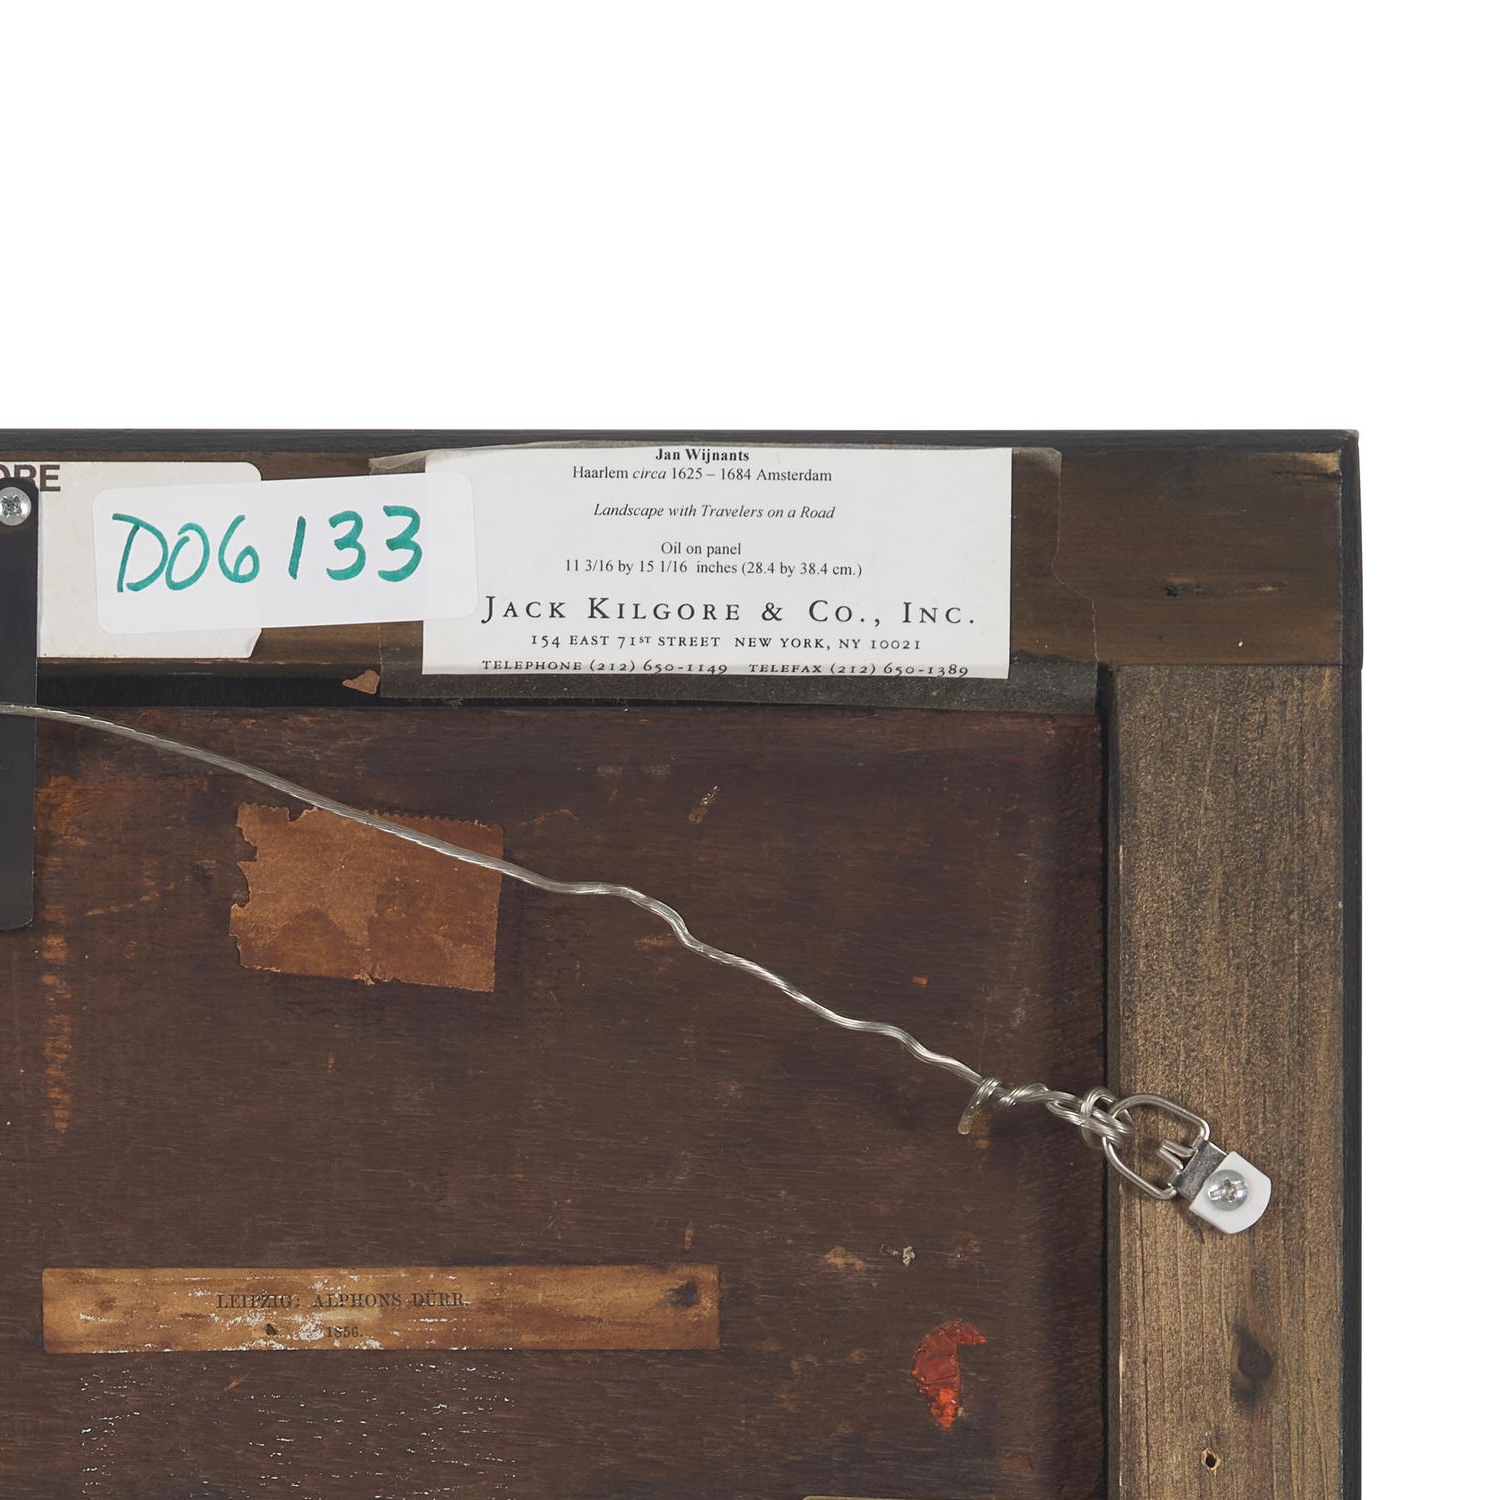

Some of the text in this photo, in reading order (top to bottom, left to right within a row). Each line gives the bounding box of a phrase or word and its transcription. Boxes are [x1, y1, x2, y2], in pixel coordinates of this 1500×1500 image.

[655, 448, 750, 464] Jan Wijnants
[573, 465, 629, 479] Haarlem
[632, 470, 667, 480] circa
[672, 467, 703, 480] 1625
[721, 468, 751, 481] 1684
[756, 468, 832, 482] Amsterdam
[593, 503, 836, 520] Landscape with Travelers on a Road
[661, 541, 741, 558] Oil on panel
[566, 559, 862, 579] 11 3/16 by 15 1/16 inches (28.4 by 38.4 cm.)
[480, 595, 566, 624] JACK
[587, 597, 740, 621] KILGORE
[761, 602, 783, 622] &
[902, 601, 974, 624] INC.
[531, 635, 560, 649] 154
[569, 635, 610, 646] EAST
[657, 636, 721, 647] STREET
[734, 637, 772, 648] NEW
[780, 637, 831, 651] YORK,
[838, 638, 861, 649] NY
[871, 639, 920, 650] 10021
[482, 660, 582, 671] TELEPHONE
[589, 659, 636, 673] (212)
[748, 663, 822, 674] TELEFAX
[828, 663, 878, 677] (212)
